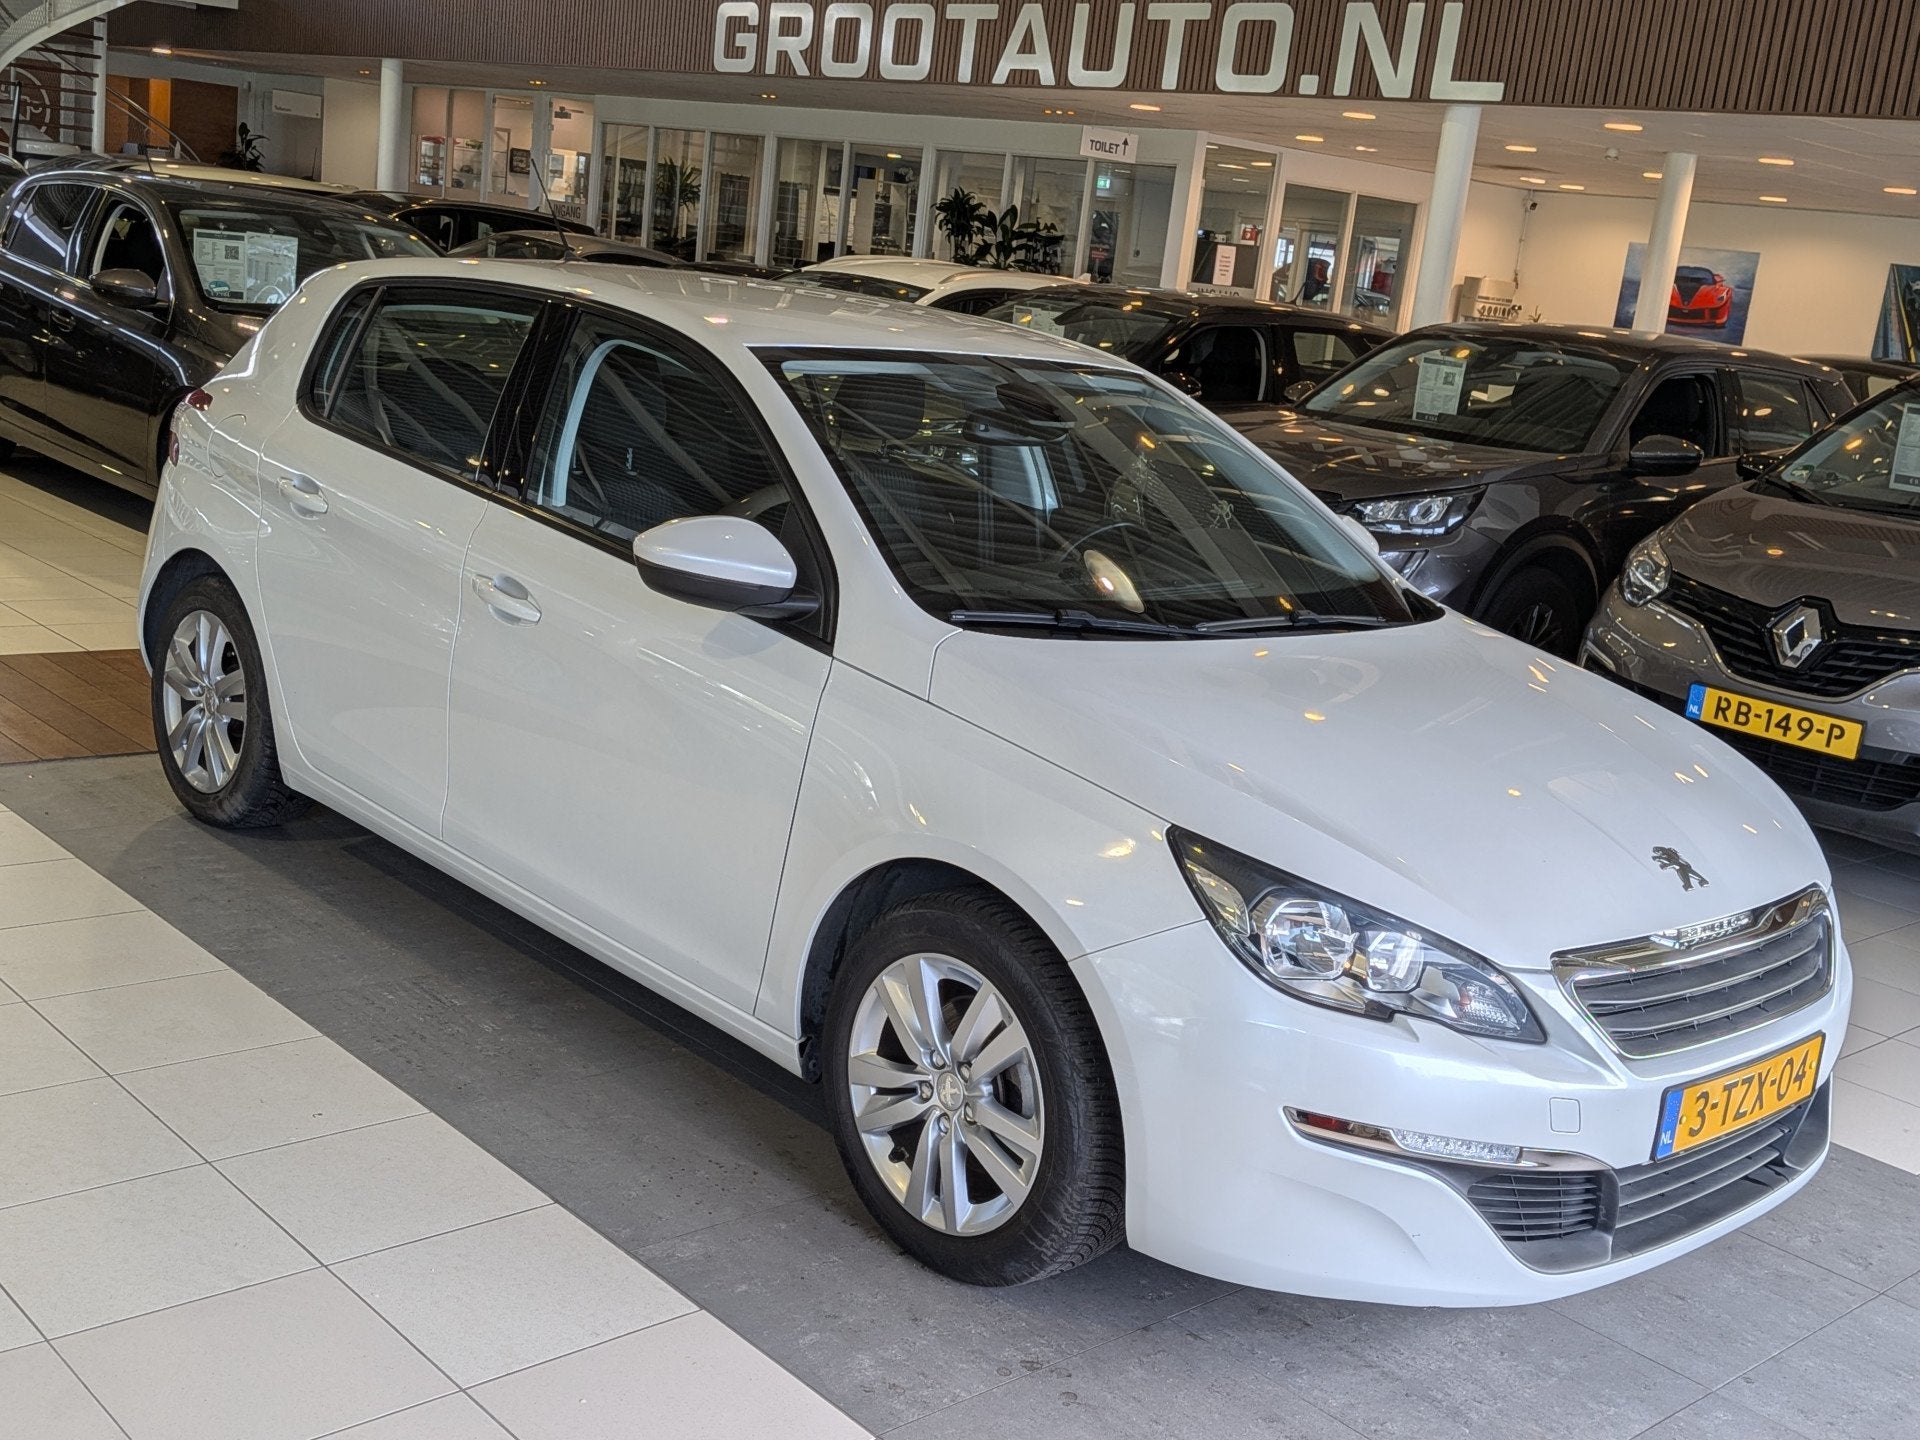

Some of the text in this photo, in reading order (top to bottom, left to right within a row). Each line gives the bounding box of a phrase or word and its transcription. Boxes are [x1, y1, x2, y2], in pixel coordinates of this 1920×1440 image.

[713, 2, 1504, 101] GROOTAUTO.NL
[1090, 139, 1120, 154] TOILET
[1689, 696, 1845, 748] NL RB-149-P
[1660, 1049, 1810, 1146] NL 3-TZX-04
